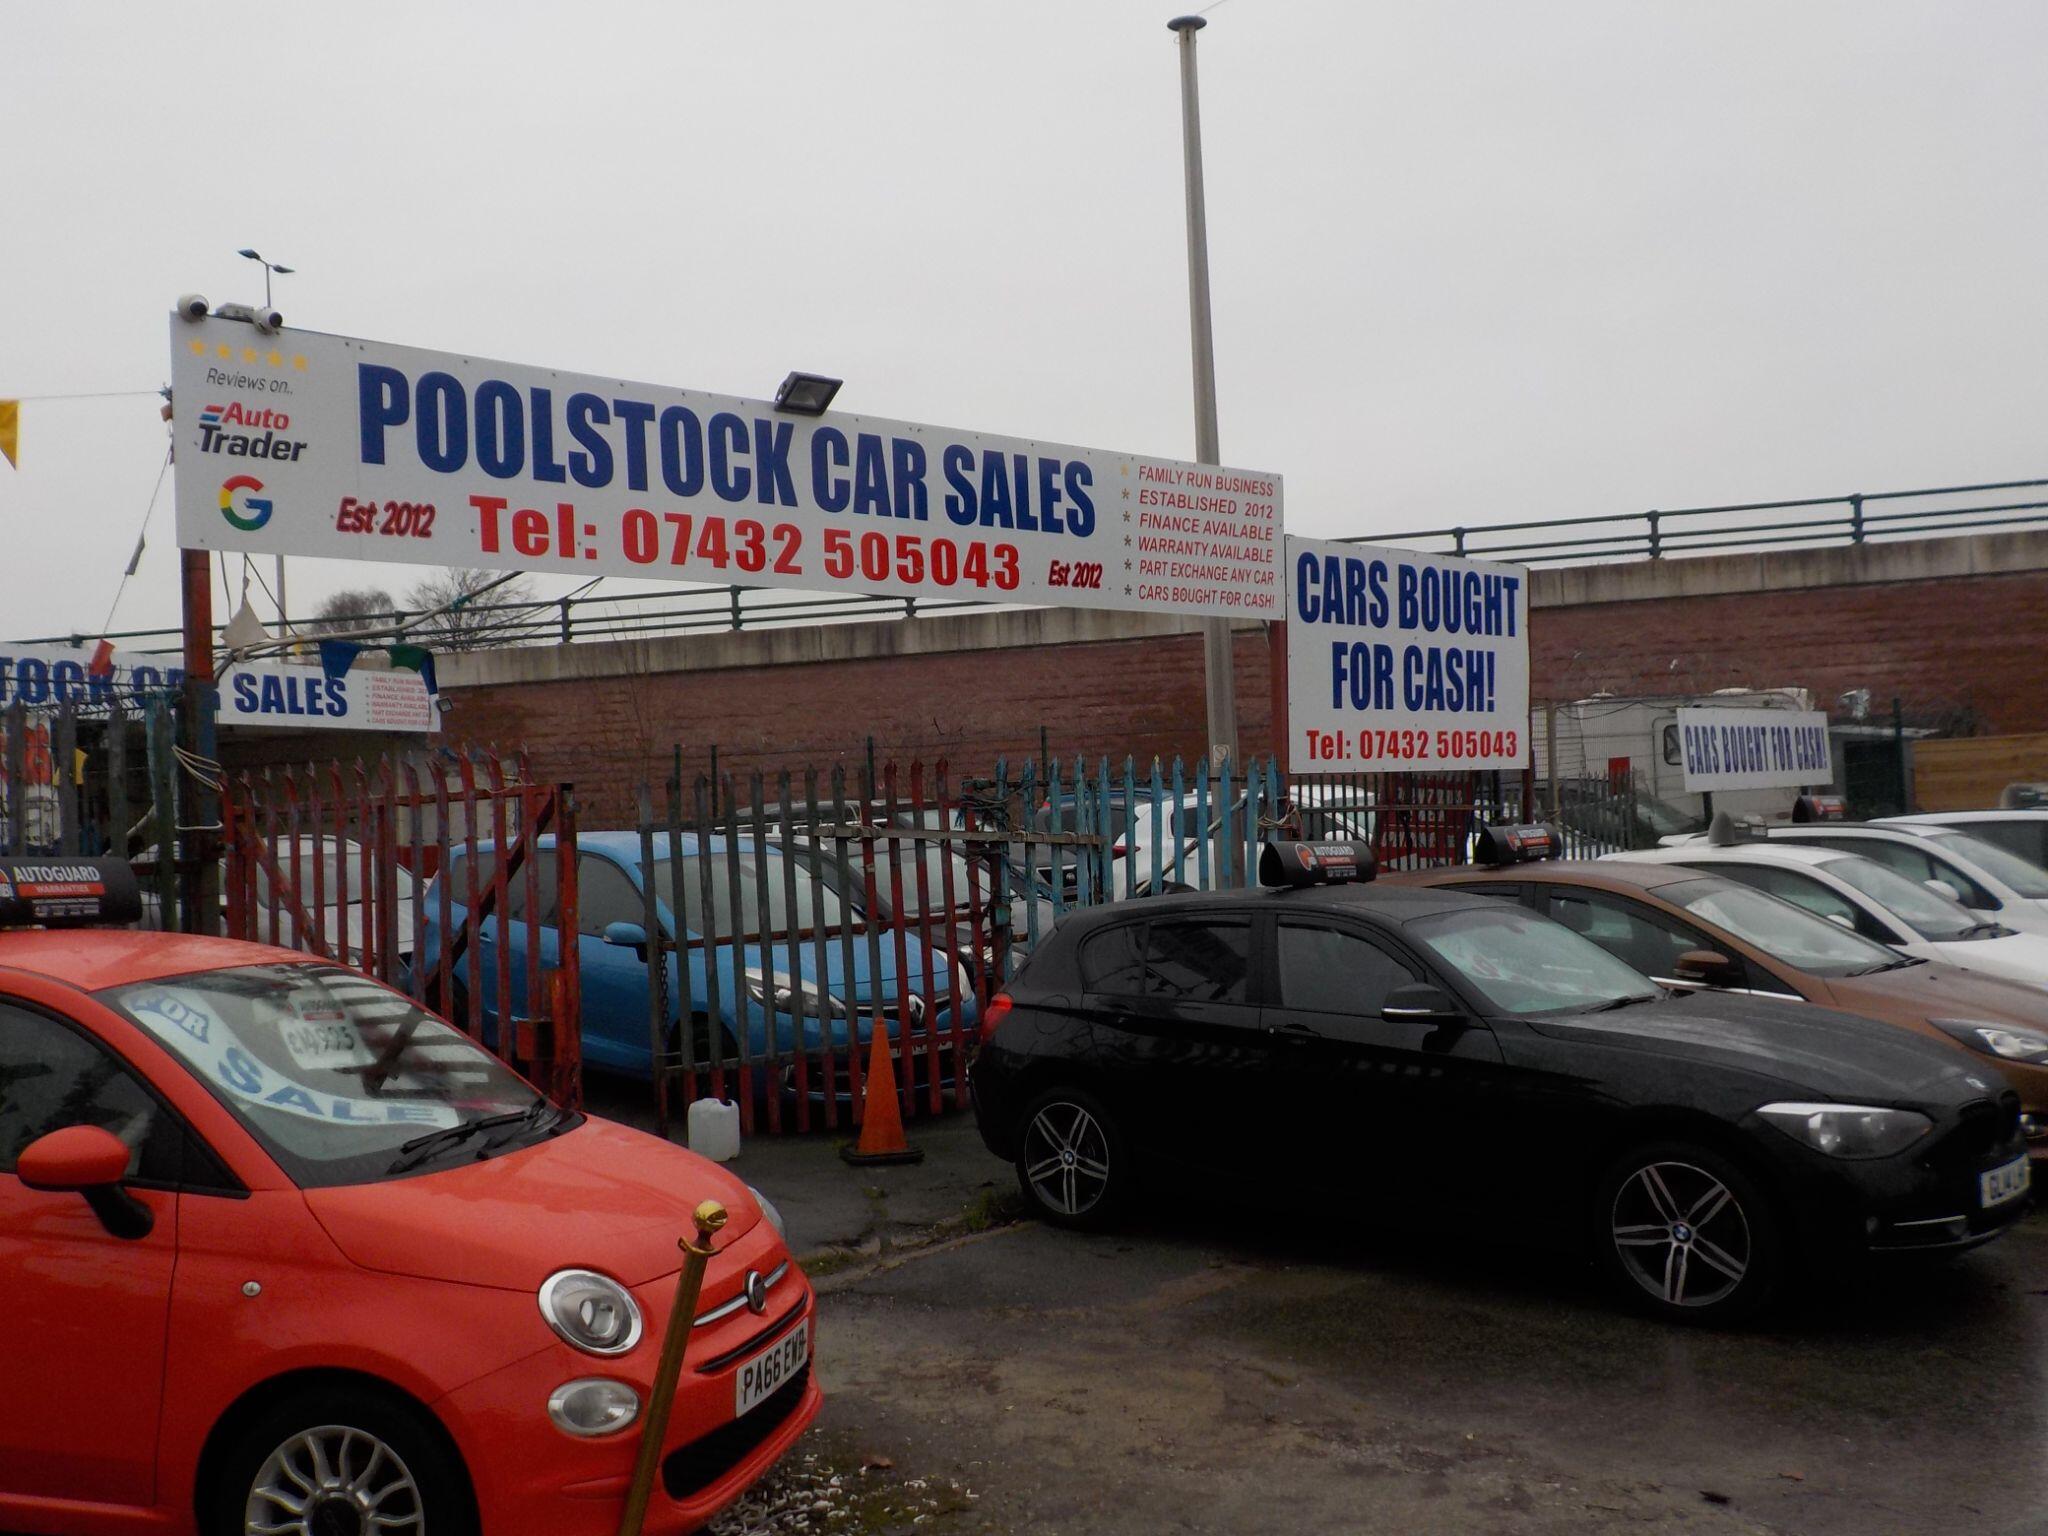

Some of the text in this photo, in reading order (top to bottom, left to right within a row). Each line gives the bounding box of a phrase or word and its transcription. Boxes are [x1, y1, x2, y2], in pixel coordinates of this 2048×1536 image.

[206, 367, 266, 391] Reviews
[222, 402, 290, 430] Auto
[199, 424, 308, 461] Trader
[358, 363, 1096, 537] POOLSTOCK CAR SALES
[1138, 465, 1274, 497] FAMILY RUN BUSINESS
[335, 496, 436, 539] Est 2012
[1139, 490, 1273, 519] ESTABLISHED 2012
[469, 494, 1020, 590] Tel: 07432 505043
[1139, 513, 1273, 541] FINANCE AVAILABLE
[1138, 536, 1273, 563] WARRANTY AVAILABLE
[1048, 560, 1103, 589] Est 2012
[1139, 560, 1274, 586] PART EXCHANGE ANY CAR
[1138, 585, 1275, 609] CARS BOUGHT FOR CASH!
[1297, 551, 1519, 637] CARS BOUGHT
[1332, 641, 1495, 713] FOR CASH!
[233, 672, 347, 717] SALES
[1306, 730, 1518, 759] Tel: 07432 505043
[1685, 725, 1828, 775] CARS BOUGHT FOR CASH!
[13, 865, 101, 882] AUTOGUARD
[217, 1046, 438, 1124] SALE
[743, 1348, 781, 1404] PA66
